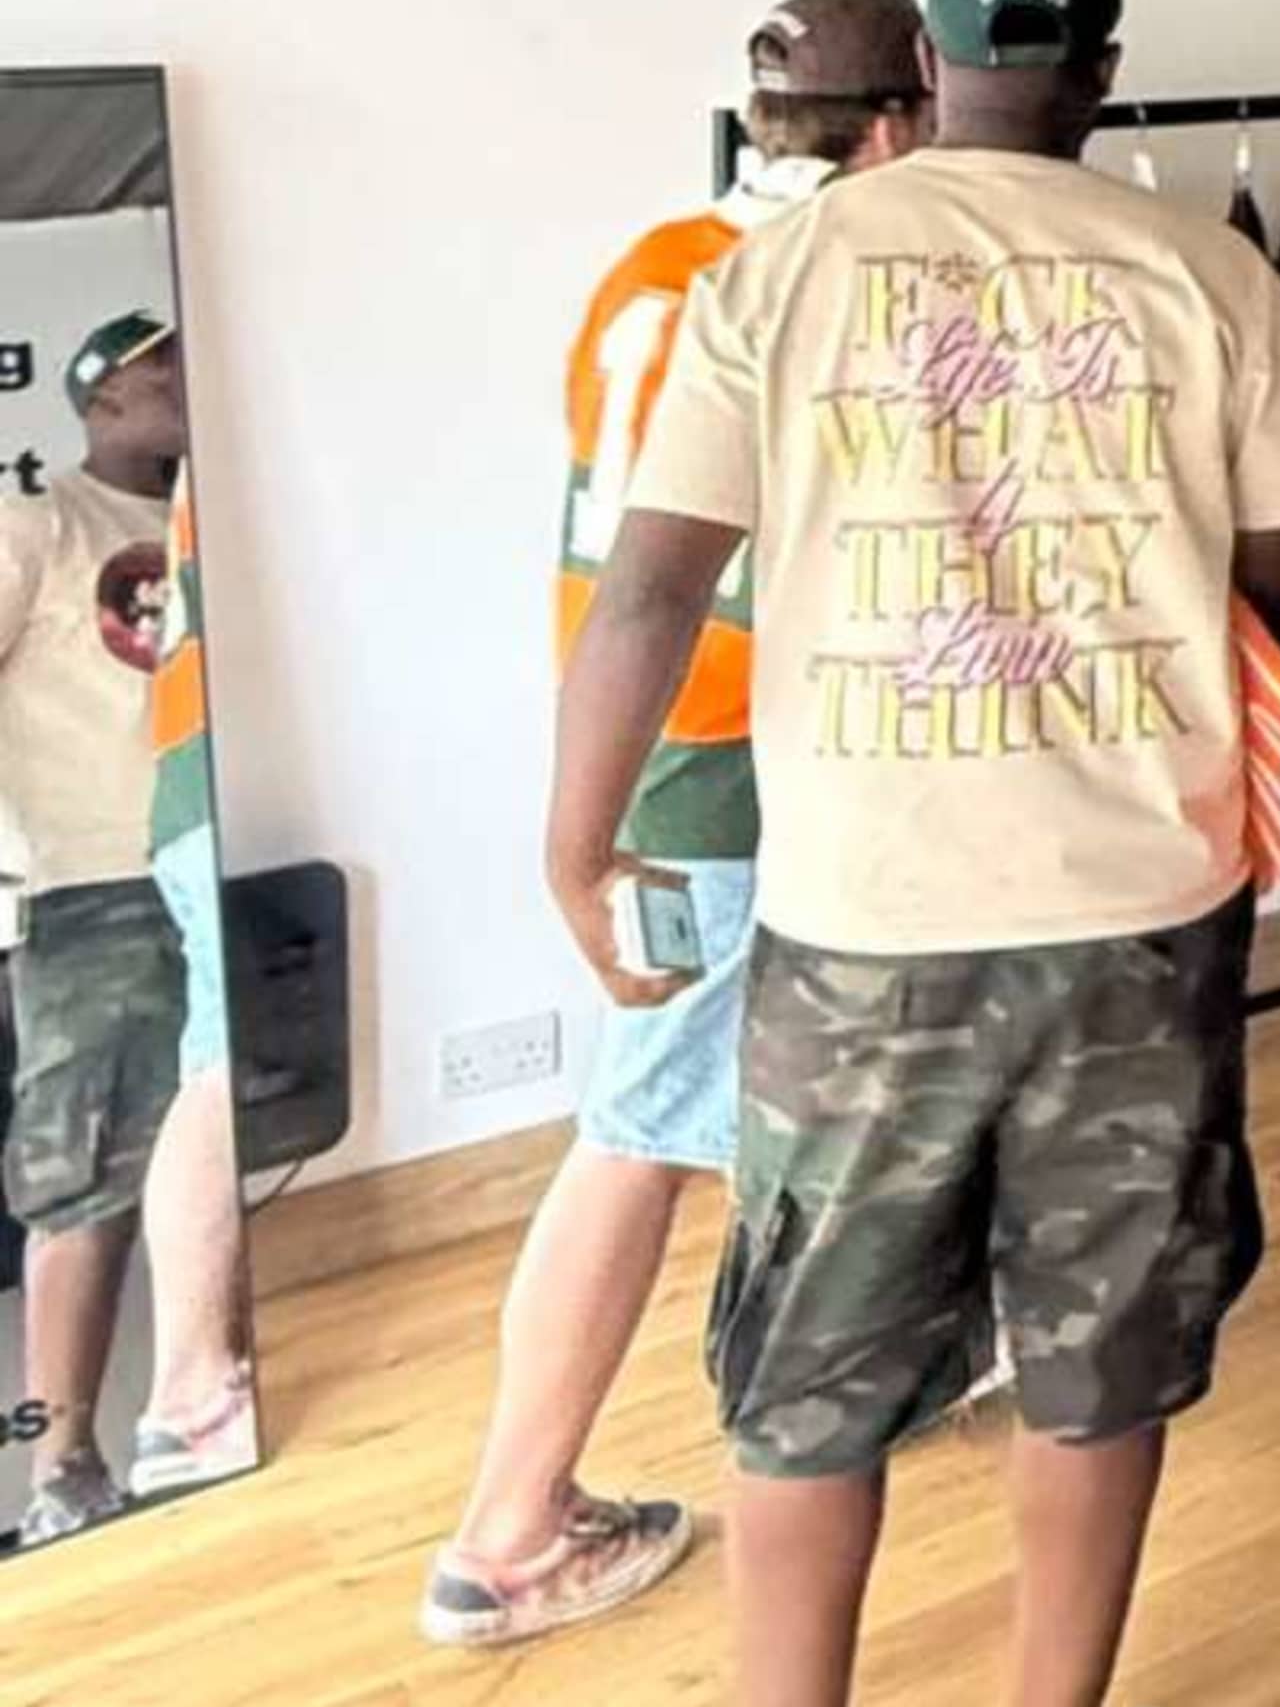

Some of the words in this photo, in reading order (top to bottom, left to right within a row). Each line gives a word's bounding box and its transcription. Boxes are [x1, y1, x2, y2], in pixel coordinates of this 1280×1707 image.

[809, 384, 1176, 484] WHAT
[835, 513, 1162, 621] THEY
[806, 638, 1192, 758] THINK
